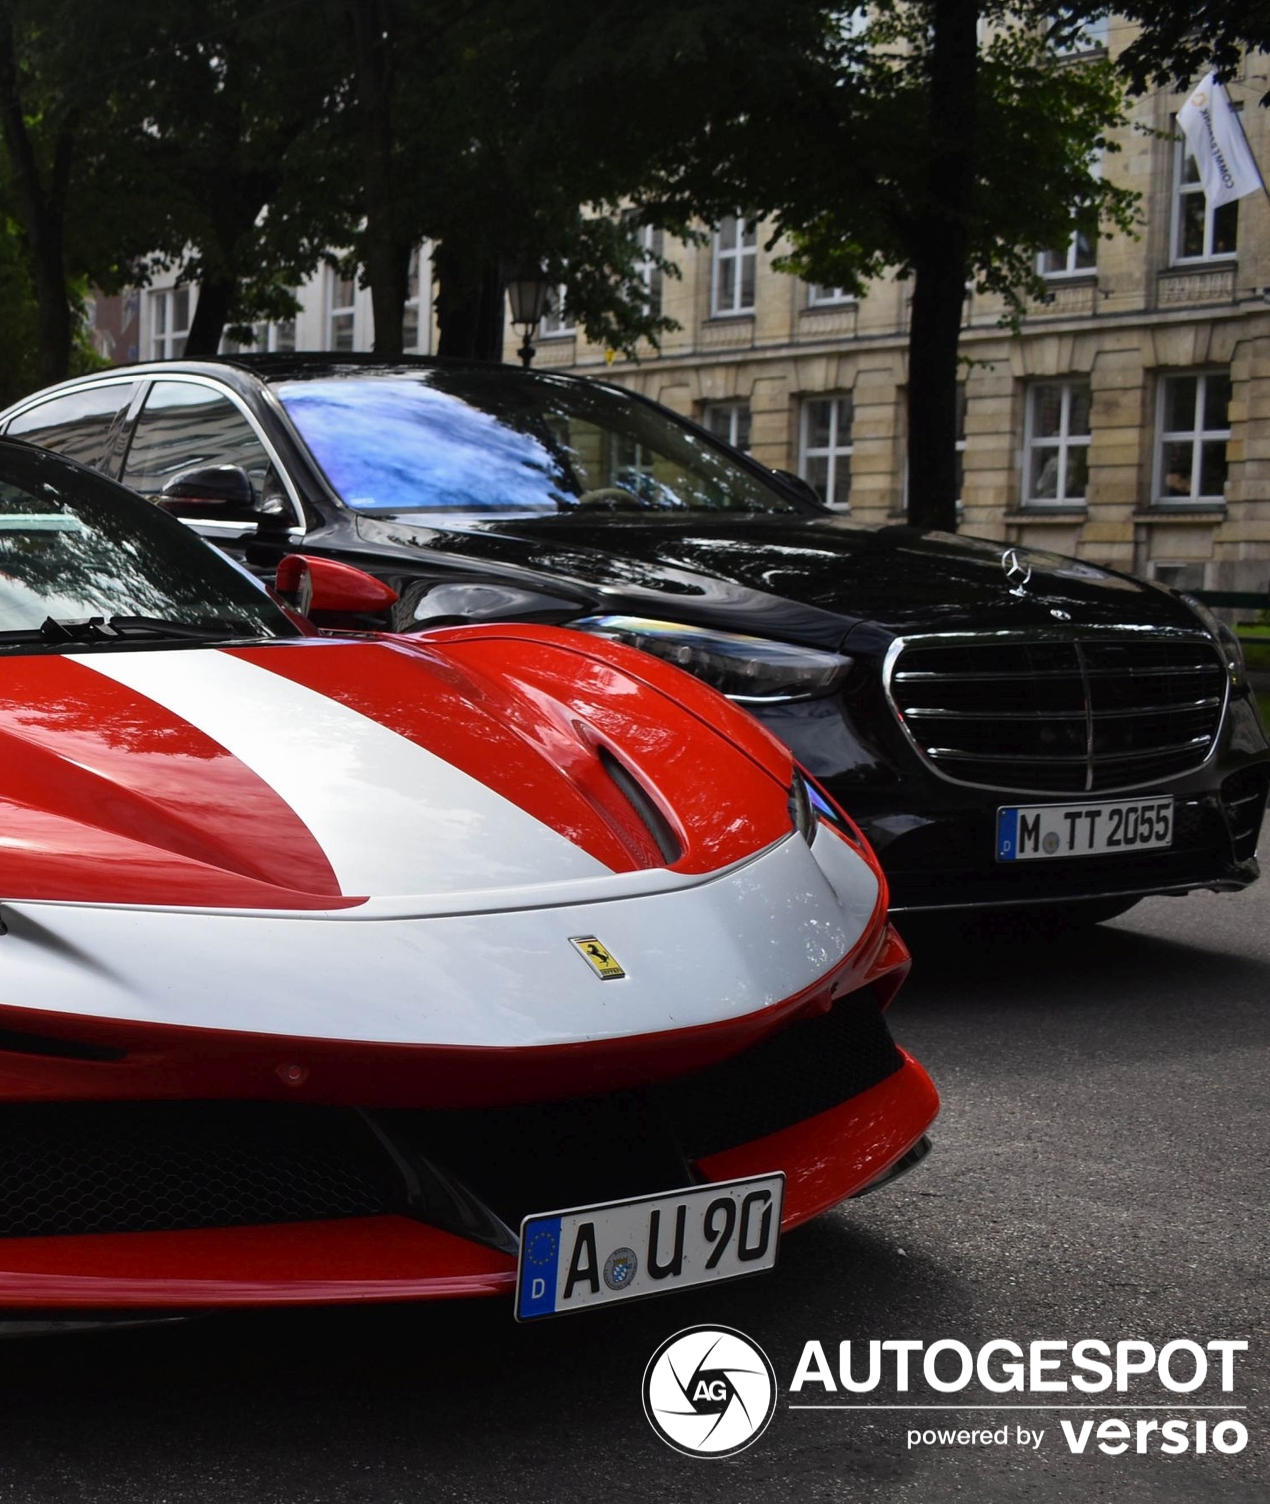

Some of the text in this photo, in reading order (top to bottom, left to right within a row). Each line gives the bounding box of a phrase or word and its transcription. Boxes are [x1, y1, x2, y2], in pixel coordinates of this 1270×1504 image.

[1019, 803, 1172, 853] M TT 2055
[1002, 840, 1011, 852] D
[563, 1222, 601, 1299] A
[647, 1205, 686, 1280] U
[703, 1189, 773, 1270] 90
[531, 1278, 545, 1299] D
